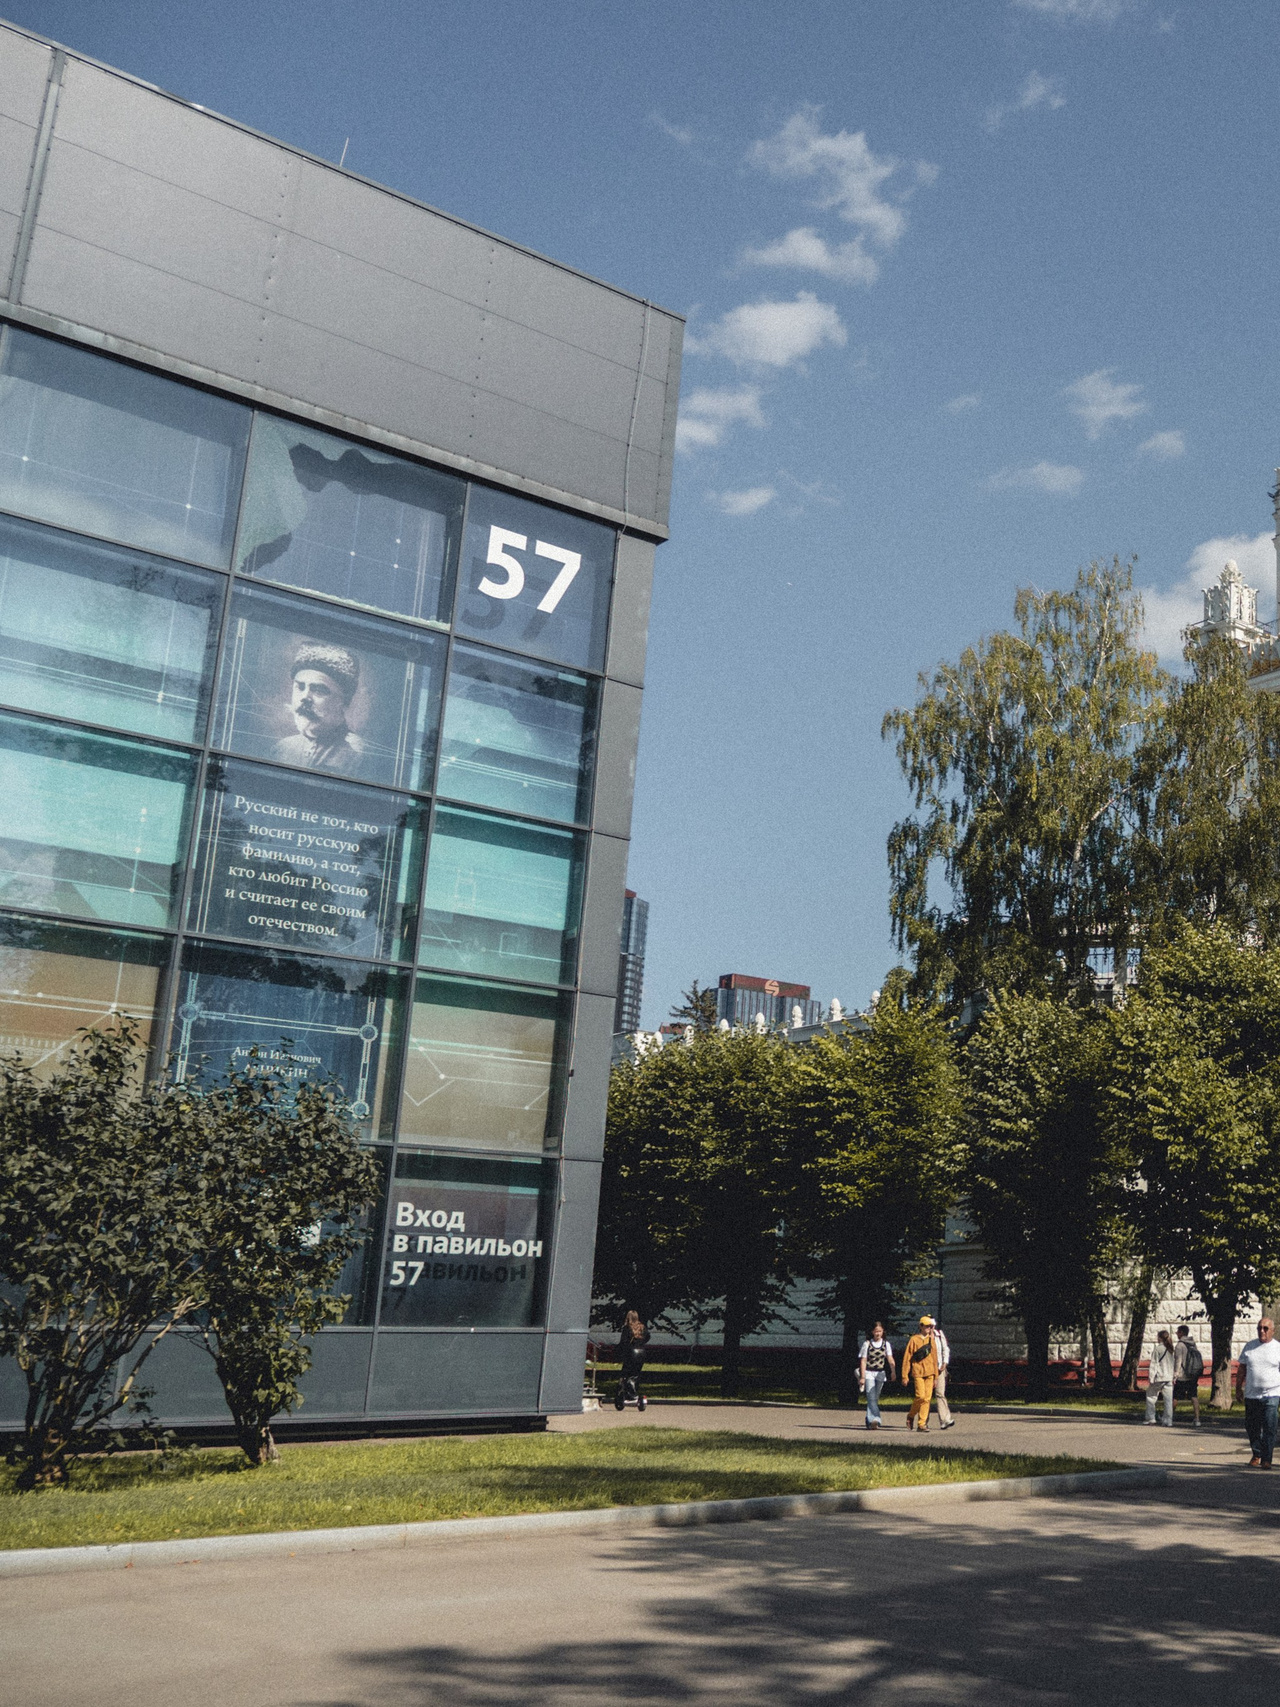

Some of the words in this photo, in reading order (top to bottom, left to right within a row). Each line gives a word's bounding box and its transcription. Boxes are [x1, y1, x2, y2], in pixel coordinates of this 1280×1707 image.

[478, 524, 582, 614] 57
[234, 795, 297, 819] Русский
[300, 811, 319, 824] не
[322, 815, 351, 831] тот,
[353, 821, 379, 834] кто
[249, 824, 294, 841] носит
[297, 832, 360, 853] русскую
[242, 843, 317, 869] фамилию,
[321, 859, 329, 870] а
[332, 861, 361, 877] тот,
[228, 866, 256, 879] кто
[258, 871, 308, 888] любит
[312, 876, 368, 898] Россию
[225, 889, 235, 899] и
[239, 889, 298, 908] считает
[301, 900, 318, 911] ее
[321, 904, 366, 919] своим
[248, 915, 339, 937] отечеством.
[396, 1201, 465, 1232] Вход
[392, 1235, 409, 1253] в
[417, 1236, 543, 1258] павильон
[389, 1261, 425, 1286] 57
